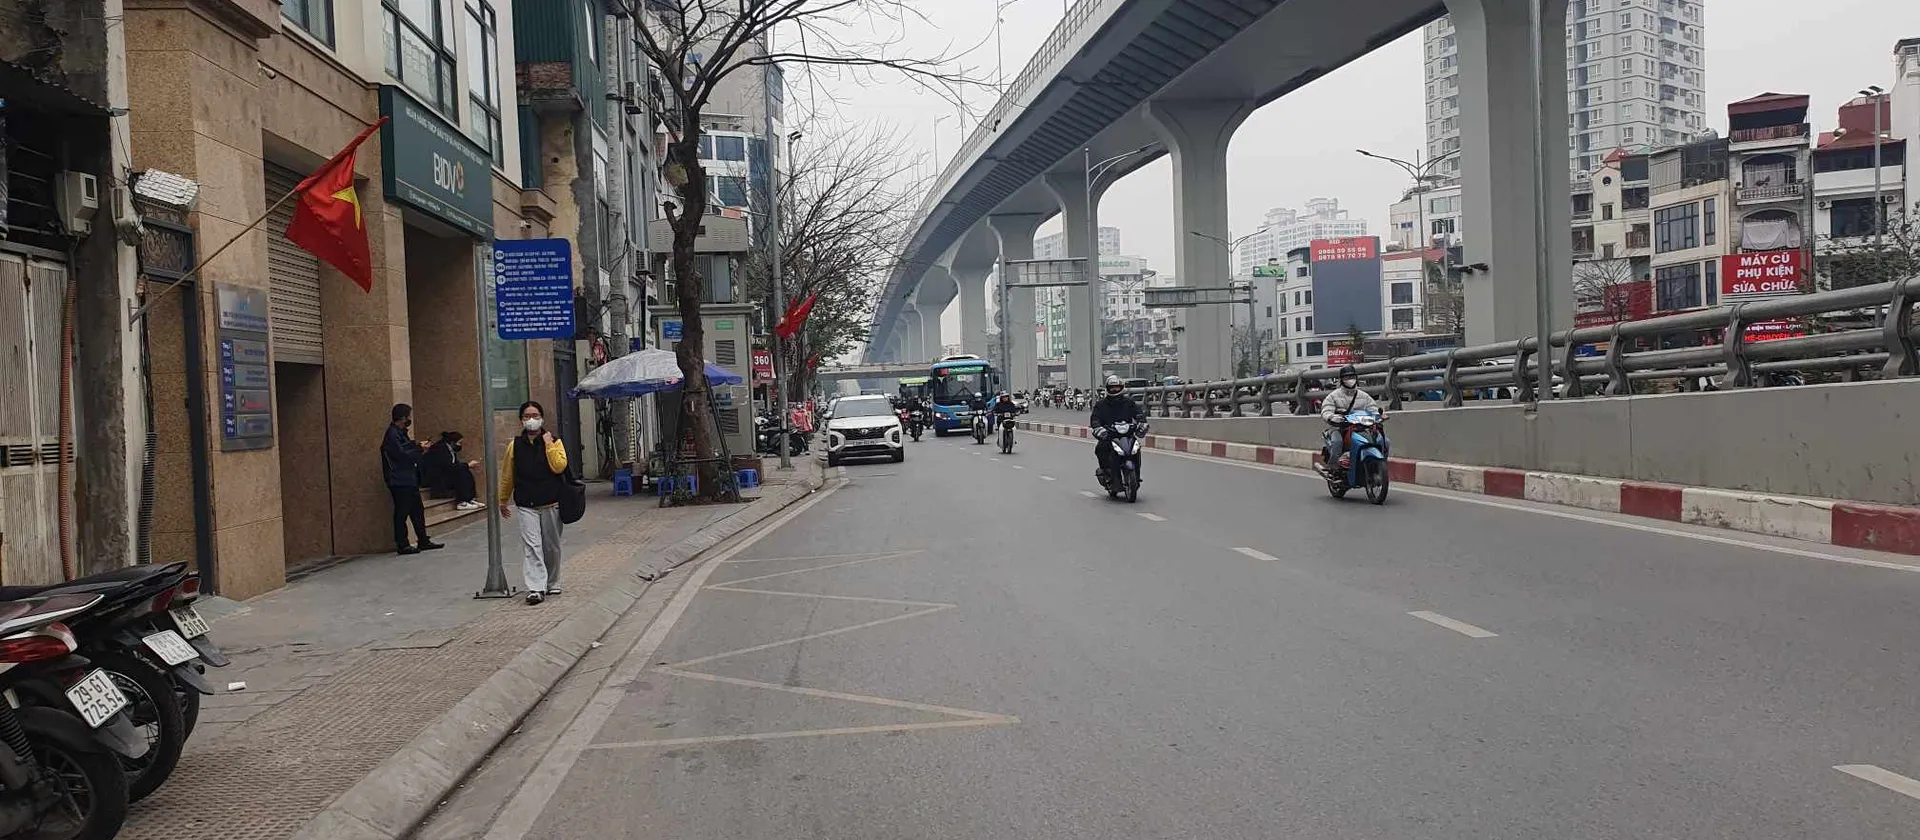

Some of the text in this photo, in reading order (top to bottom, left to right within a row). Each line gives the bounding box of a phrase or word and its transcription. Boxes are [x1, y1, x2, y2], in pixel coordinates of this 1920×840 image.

[433, 151, 457, 194] BIDV
[1741, 252, 1790, 267] MÁY CŨ
[1737, 265, 1793, 280] PHỤ KIỆN
[1733, 280, 1756, 293] SỬA
[754, 356, 769, 365] 360
[73, 675, 108, 705] 29-G1
[84, 689, 124, 725] 725.54
